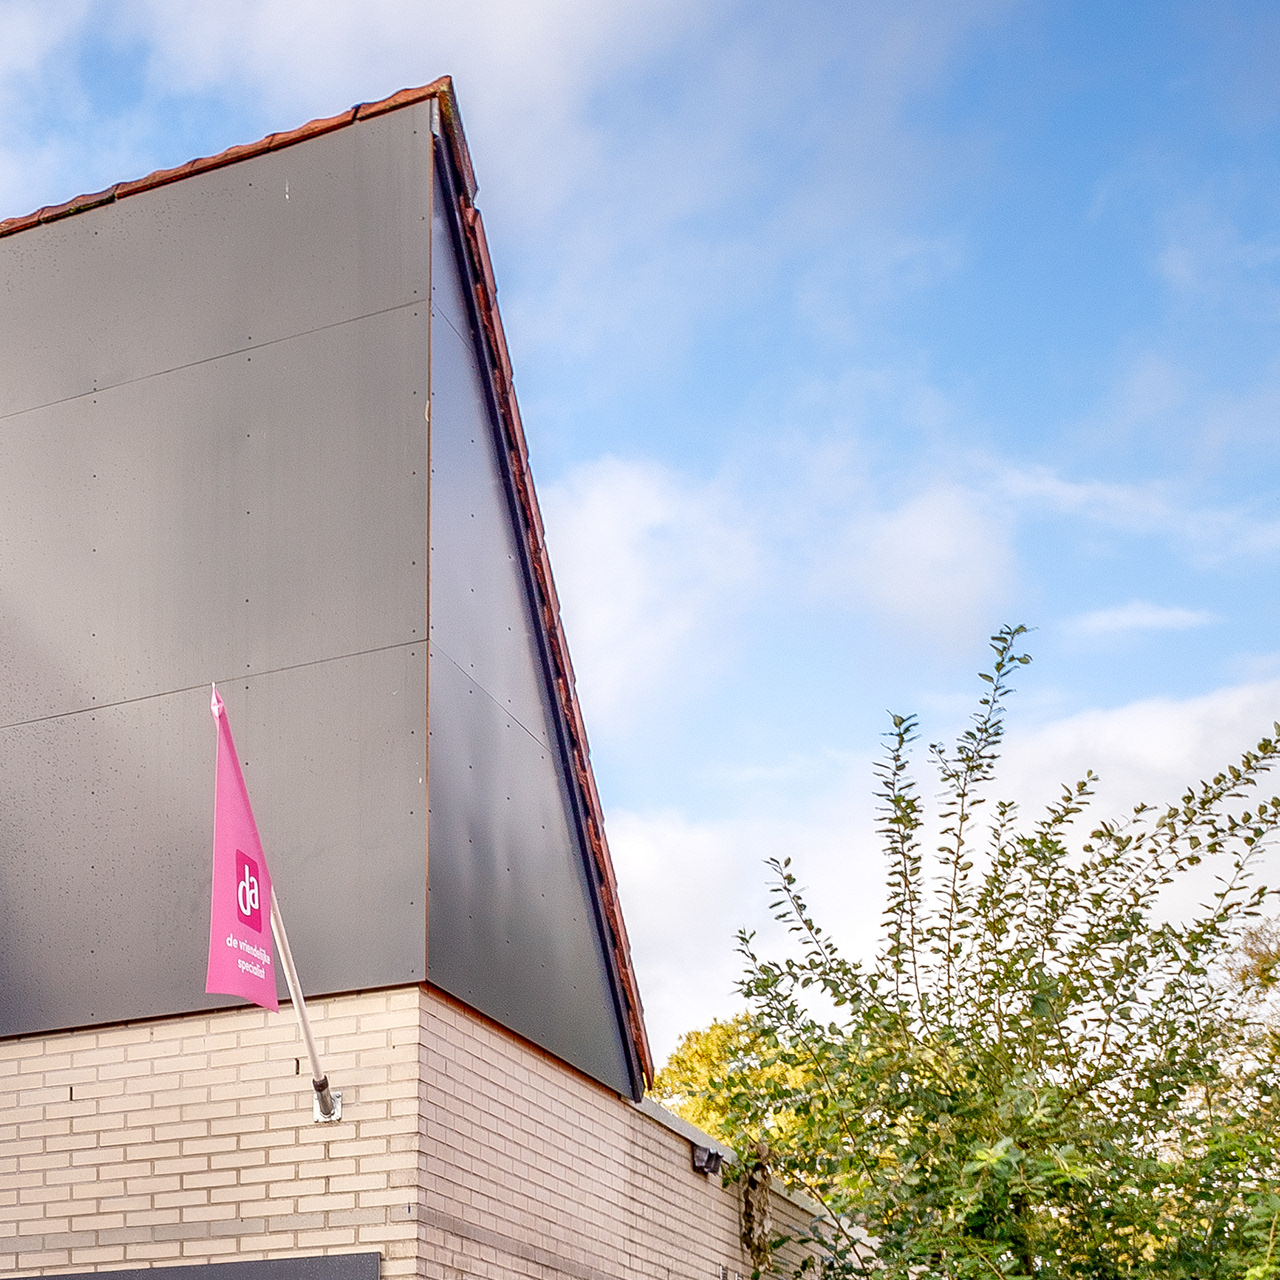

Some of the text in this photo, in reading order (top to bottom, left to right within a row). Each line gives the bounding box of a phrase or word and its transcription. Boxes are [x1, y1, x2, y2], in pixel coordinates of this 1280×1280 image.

[237, 863, 259, 916] da
[226, 933, 271, 965] de vriendelijke
[237, 957, 266, 980] specialist
